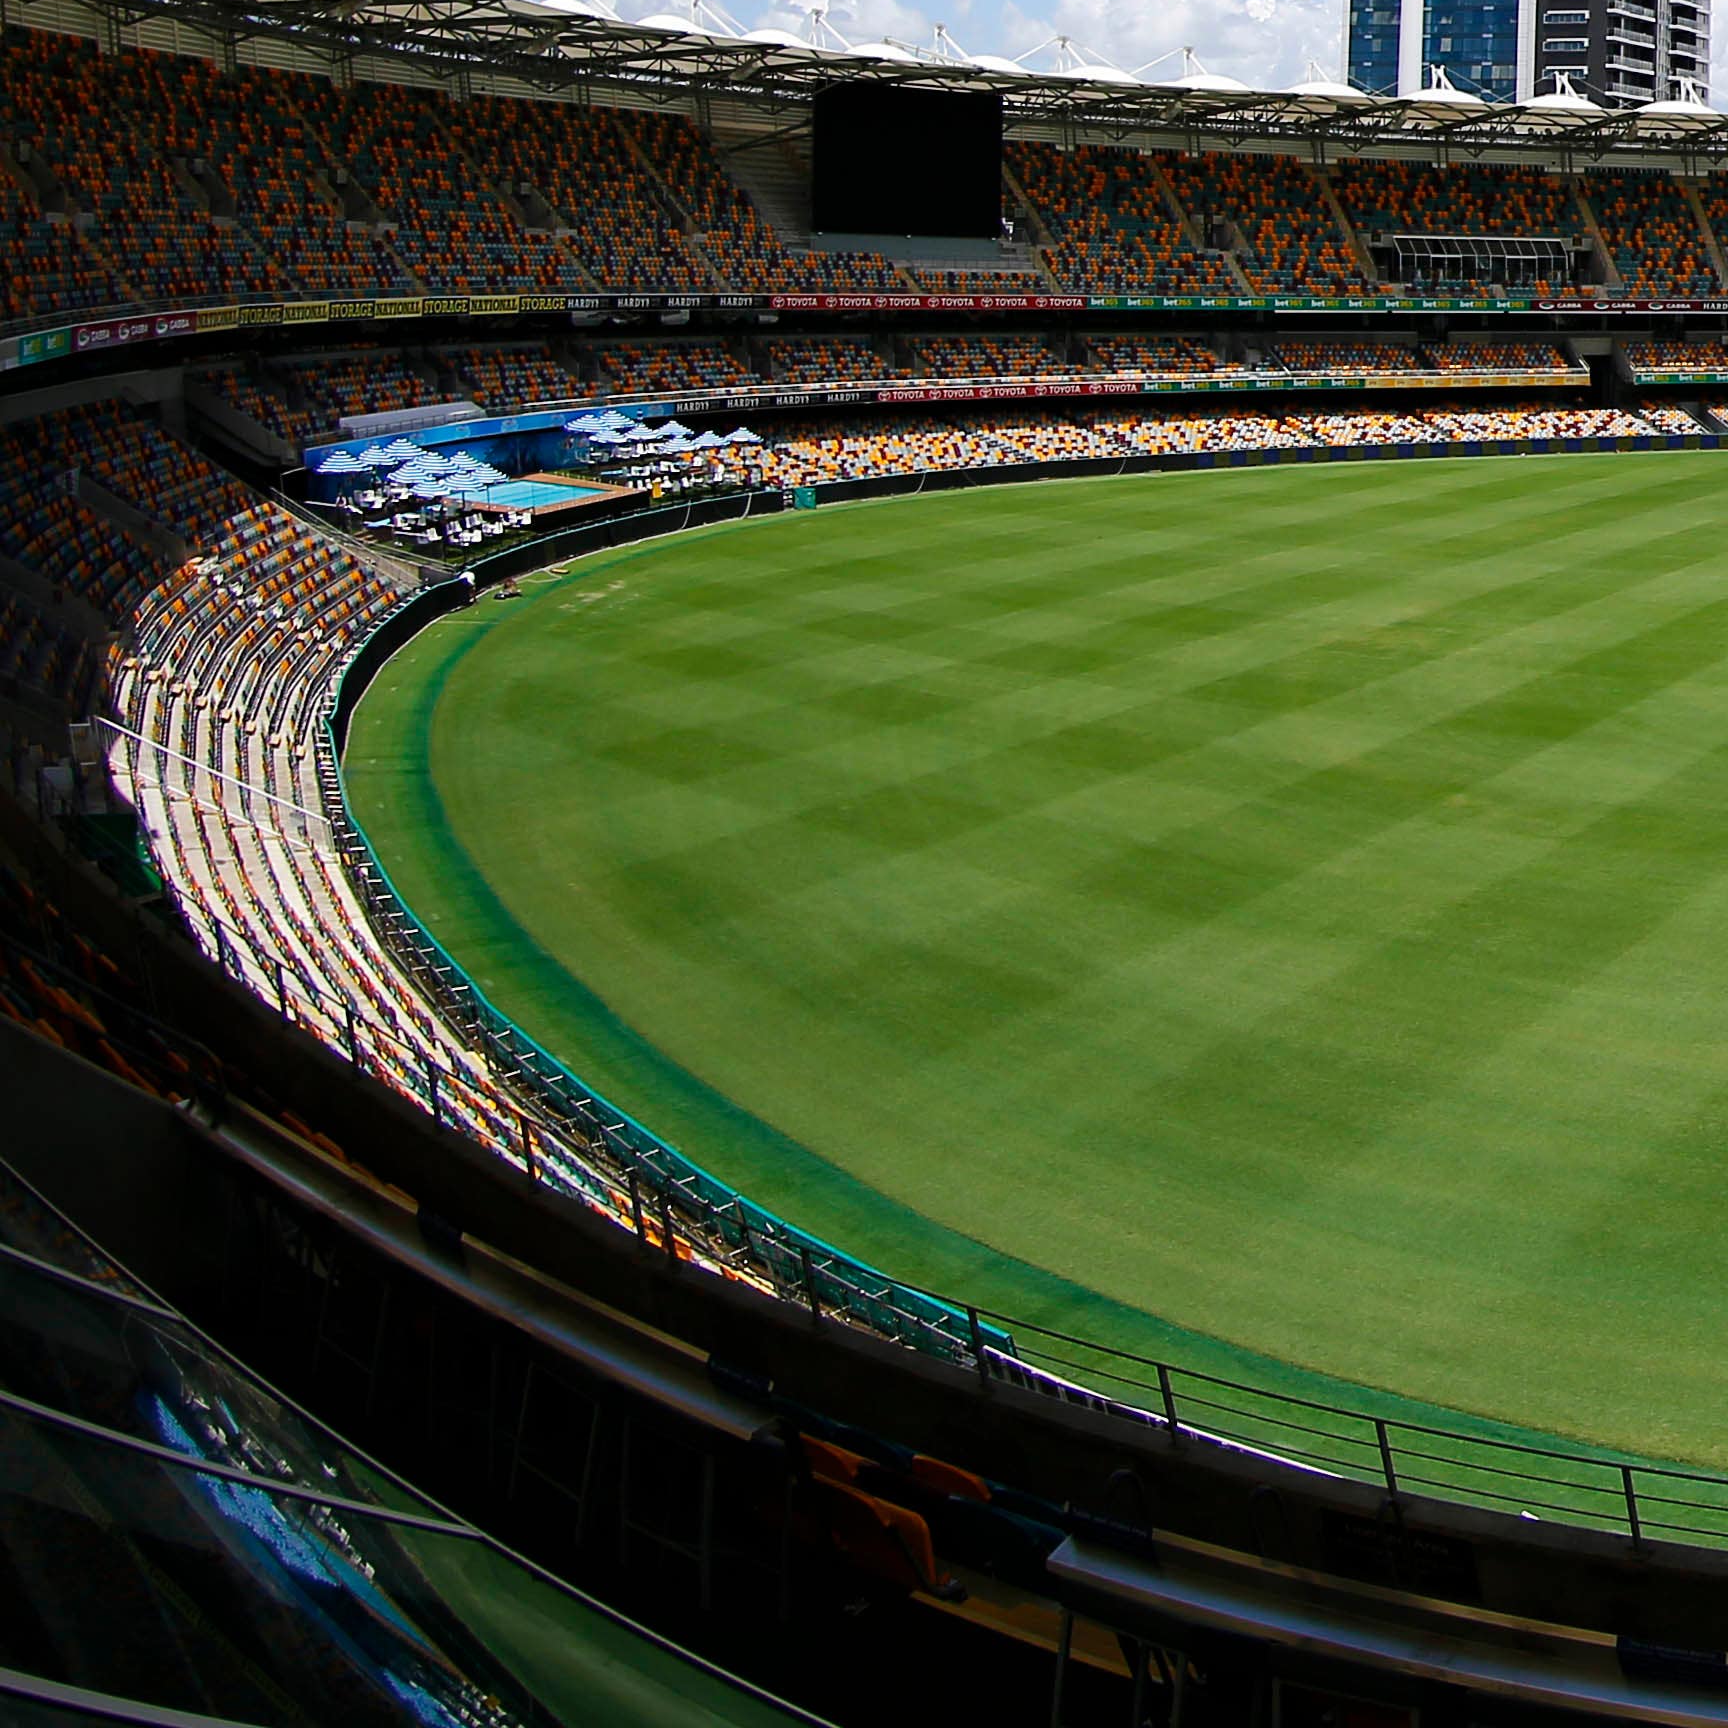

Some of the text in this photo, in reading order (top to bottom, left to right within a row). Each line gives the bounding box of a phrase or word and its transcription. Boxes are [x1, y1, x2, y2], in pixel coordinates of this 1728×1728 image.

[521, 298, 565, 311] STORAGE
[787, 298, 817, 307] TOYOTA
[840, 298, 871, 307] TOYOTA
[889, 298, 920, 307] TOYOTA
[943, 298, 974, 307] TOYOTA
[996, 298, 1027, 307] TOYOTA
[1050, 298, 1082, 306] TOYOTA
[330, 302, 374, 319] STORAGE
[424, 299, 468, 315] STORAGE
[240, 306, 283, 324] STORAGE
[994, 387, 1026, 396] TOYOTA
[1049, 385, 1080, 393] TOYOTA
[1104, 384, 1136, 392] TOYOTA
[893, 390, 924, 400] TOYOTA
[943, 388, 974, 398] TOYOTA
